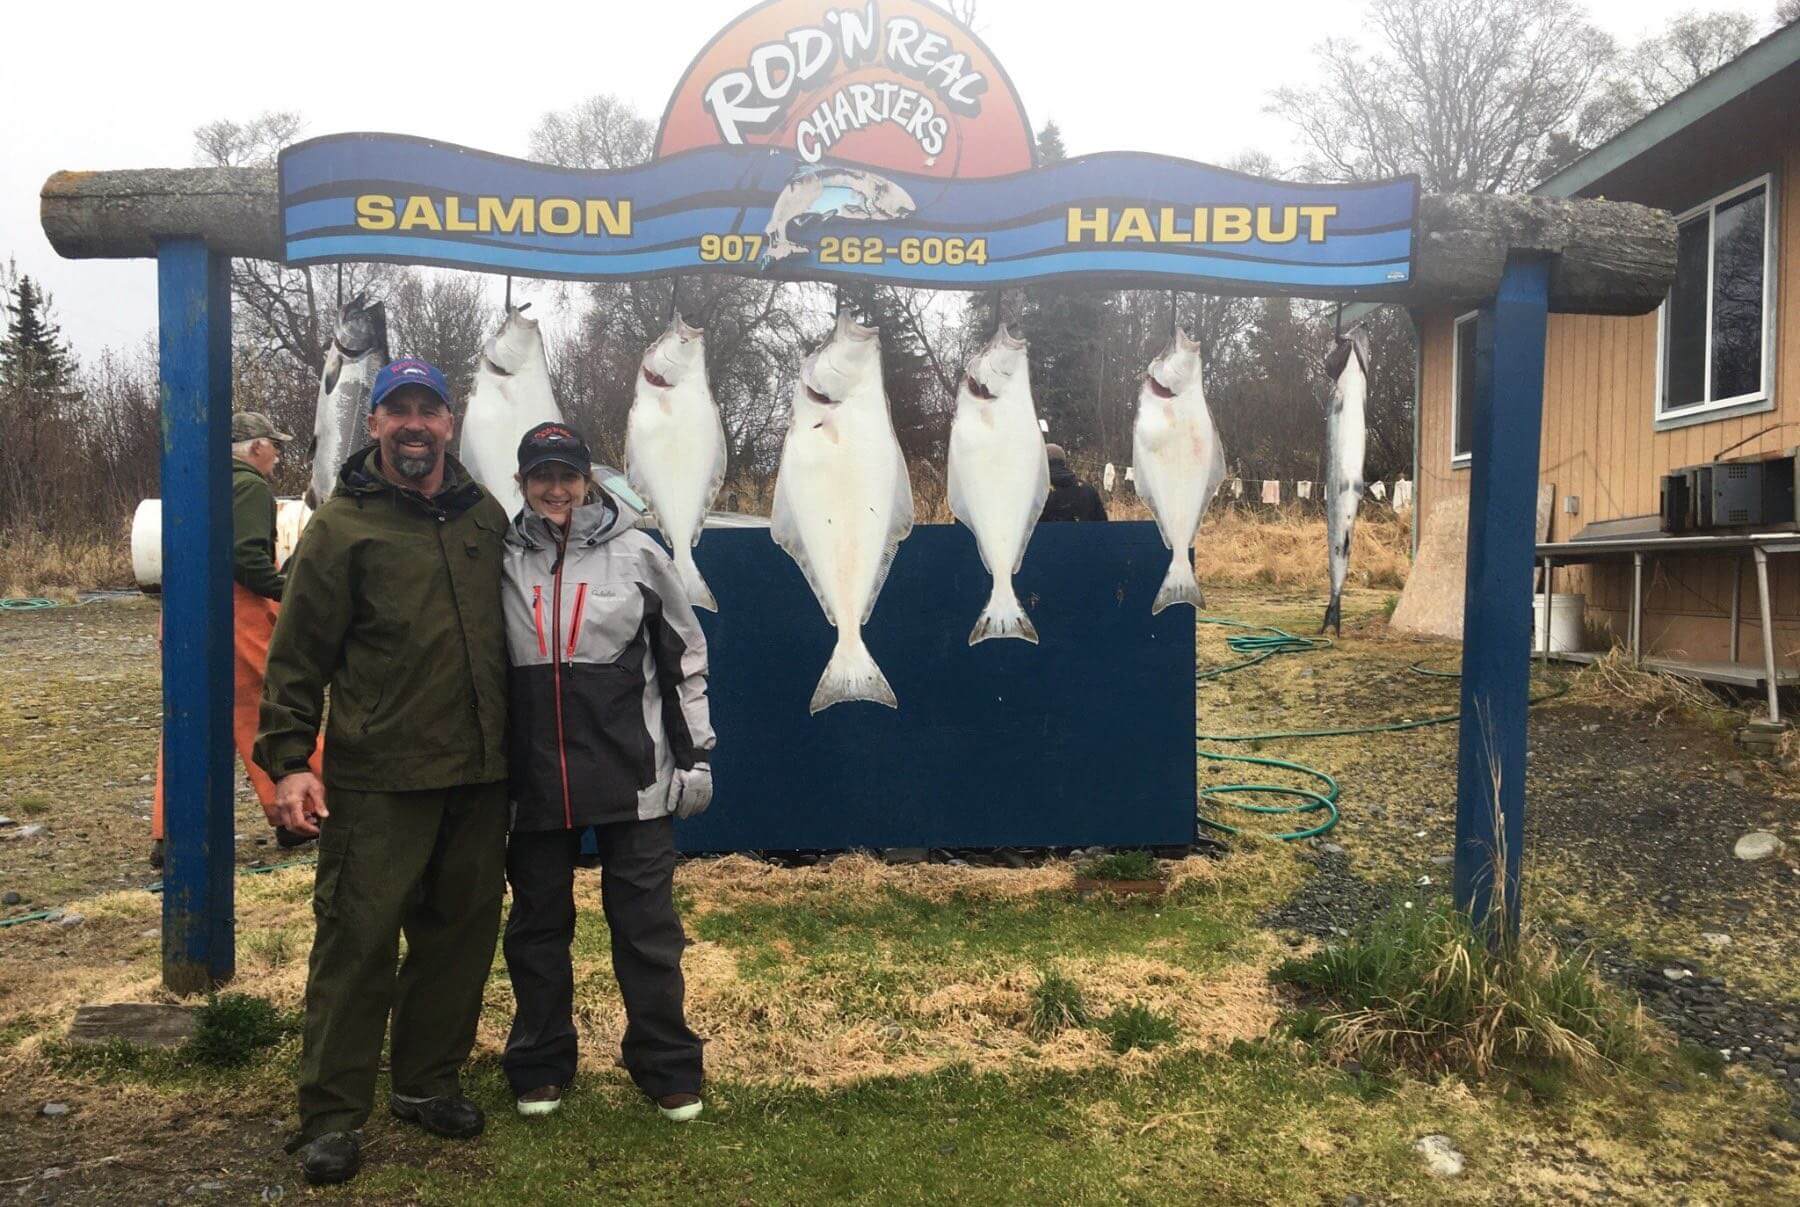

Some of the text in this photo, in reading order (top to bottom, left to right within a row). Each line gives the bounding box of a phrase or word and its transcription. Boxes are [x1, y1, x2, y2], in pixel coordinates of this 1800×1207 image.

[887, 18, 987, 105] REAL
[796, 82, 948, 163] CHARTERS
[356, 194, 632, 236] SALMON
[1067, 206, 1337, 242] HALIBUT
[700, 234, 987, 265] 907 262-6064
